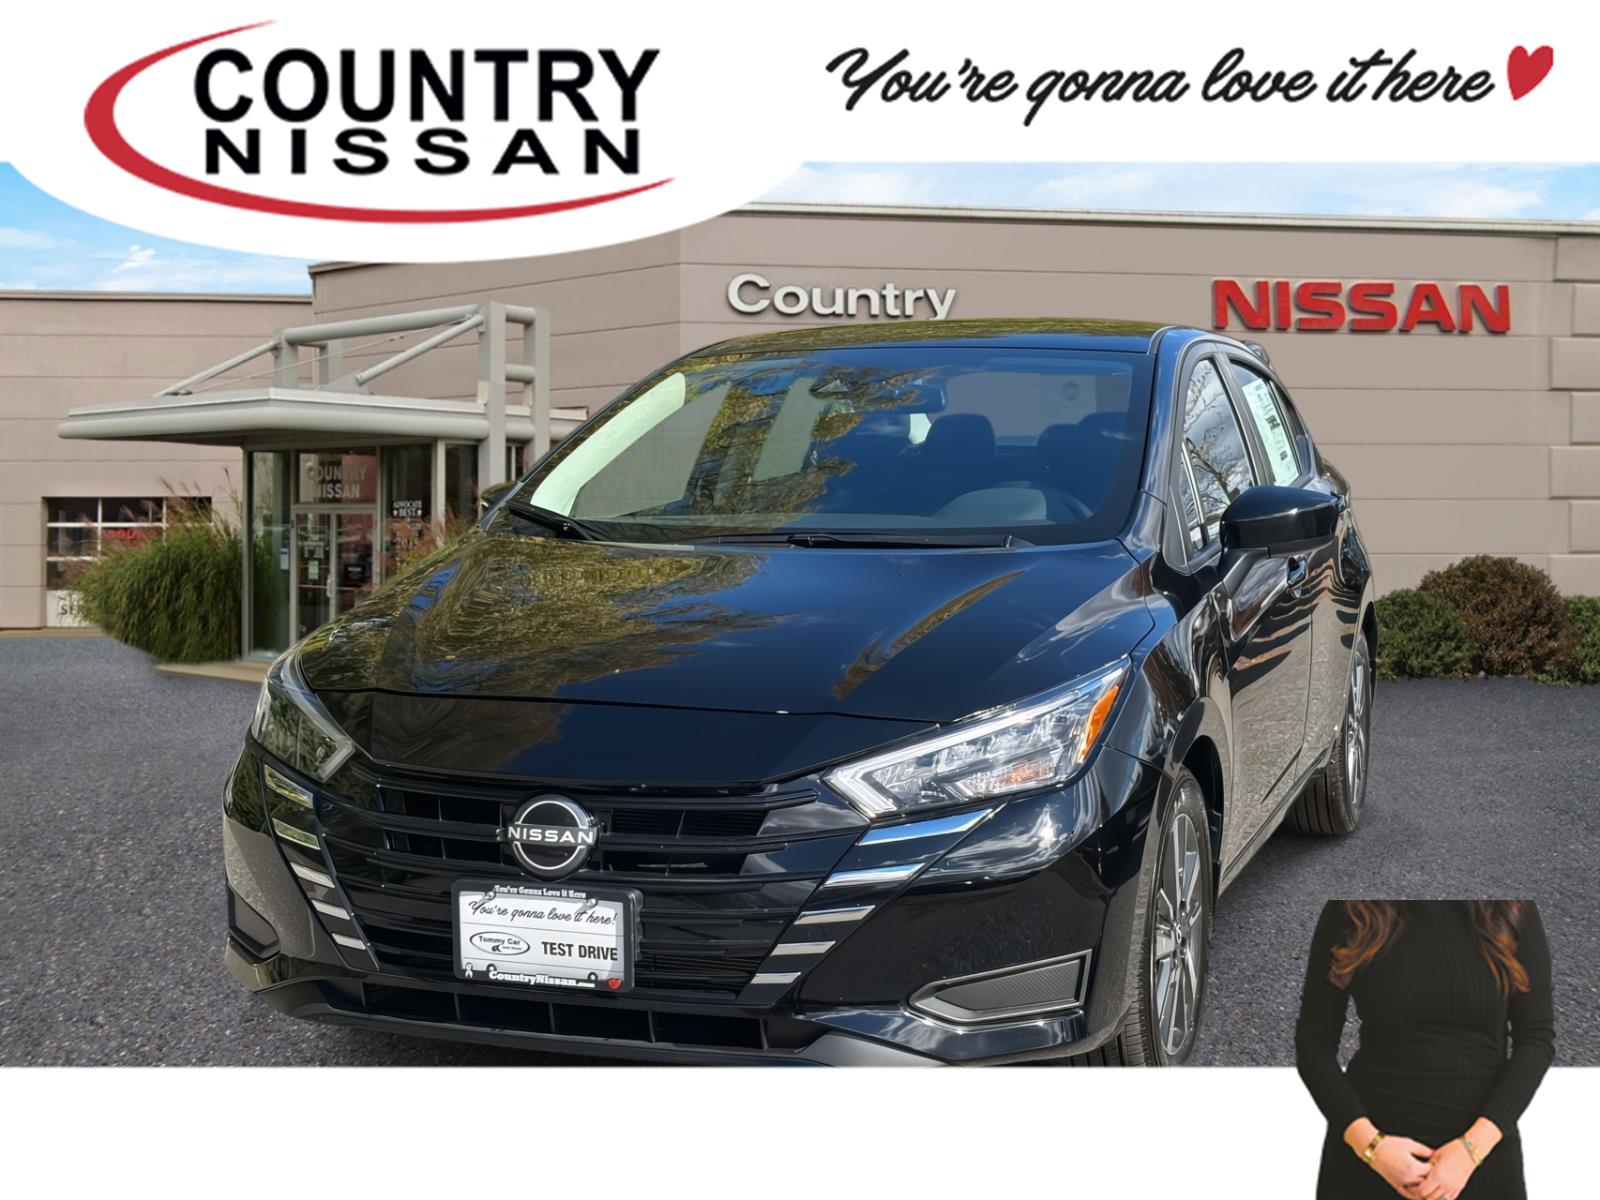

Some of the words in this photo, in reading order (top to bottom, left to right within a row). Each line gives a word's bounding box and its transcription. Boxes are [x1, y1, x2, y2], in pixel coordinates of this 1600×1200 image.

[727, 273, 956, 322] Country
[1213, 278, 1511, 333] NISSAN
[312, 465, 367, 481] OUNRY
[507, 826, 594, 844] NISSAN
[468, 900, 508, 915] You're
[511, 909, 545, 922] gonna
[547, 907, 572, 922] love
[585, 911, 617, 926] here!
[478, 935, 505, 946] Tommy
[507, 937, 521, 946] Car
[541, 941, 574, 957] TEST
[578, 944, 618, 961] DRIVE
[488, 970, 595, 988] CountryNissan.
